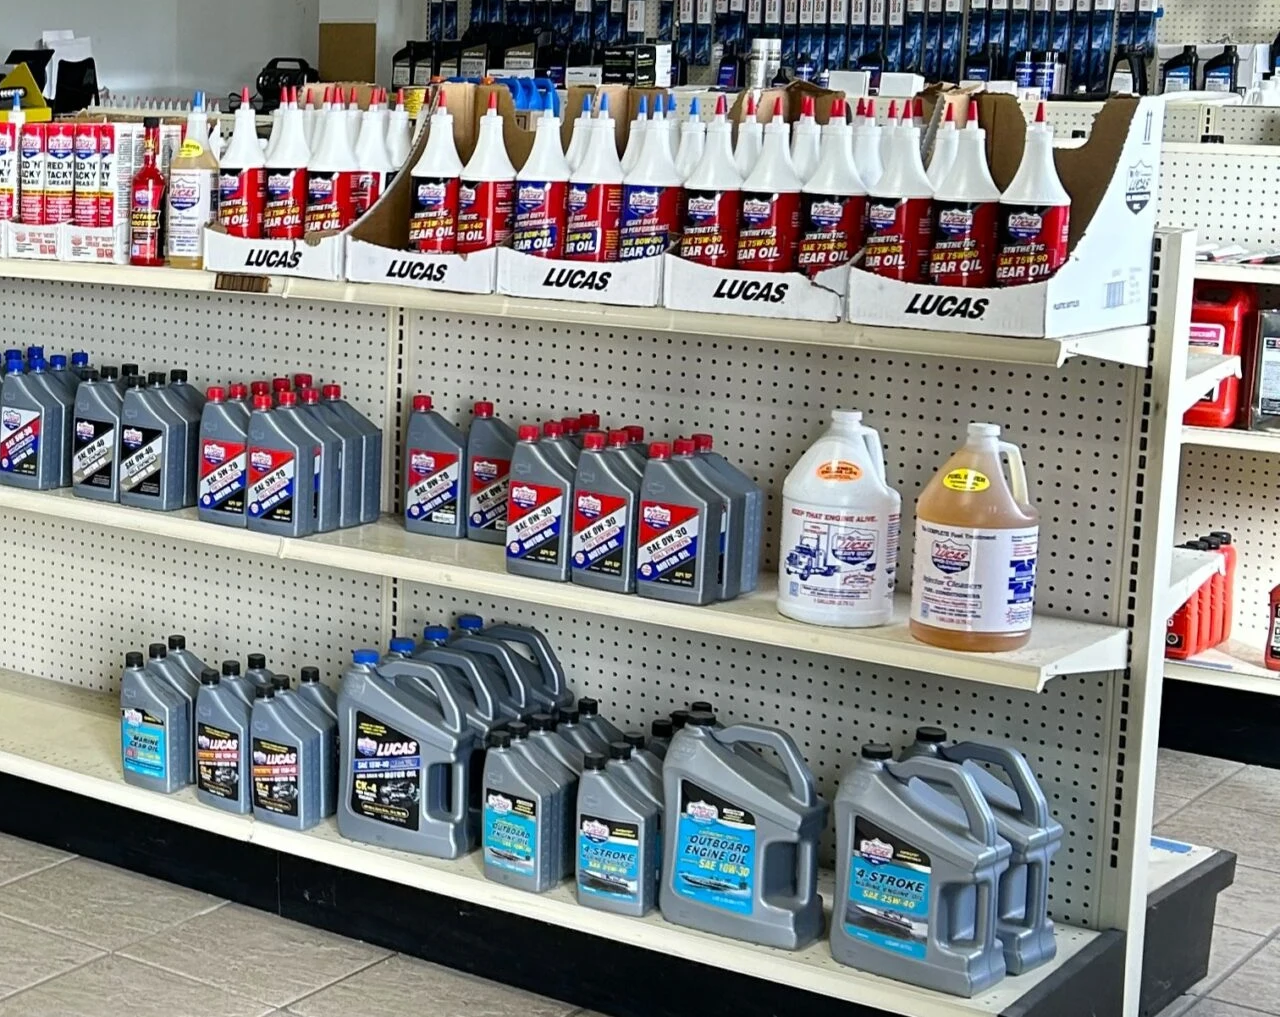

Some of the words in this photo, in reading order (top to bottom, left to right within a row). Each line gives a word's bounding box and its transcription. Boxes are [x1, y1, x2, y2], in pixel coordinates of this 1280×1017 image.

[47, 162, 63, 170] RED
[231, 215, 249, 225] OIL
[283, 215, 301, 225] OIL
[323, 219, 341, 229] OIL
[409, 229, 433, 240] GEAR
[436, 226, 455, 236] OIL
[467, 231, 484, 240] OIL
[534, 238, 553, 248] OIL
[694, 236, 722, 244] 75W-90
[748, 238, 776, 246] 75W-90
[935, 239, 976, 249] SYNTHETIC
[576, 241, 595, 251] OIL
[705, 244, 726, 255] OIL
[802, 243, 815, 251] SAE
[817, 242, 847, 250] 75W-90
[1003, 244, 1045, 254] SYNTHETIC
[758, 247, 780, 258] OIL
[799, 252, 825, 263] GEAR
[829, 251, 849, 262] OIL
[933, 253, 945, 261] SAE
[245, 249, 303, 268] LUCAS
[883, 255, 905, 266] OIL
[1000, 257, 1013, 265] SAE
[1016, 254, 1048, 264] 75W-90
[386, 260, 448, 281] LUCAS
[930, 262, 955, 274] GEAR
[960, 260, 983, 271] OIL
[997, 266, 1025, 278] GEAR
[1028, 264, 1051, 277] OIL
[543, 267, 612, 290] LUCAS
[713, 279, 789, 303] LUCAS
[905, 293, 990, 319] LUCAS
[415, 486, 427, 496] SAE
[515, 521, 528, 532] SAE
[529, 507, 552, 524] 0W-30
[806, 511, 822, 520] THAT
[580, 531, 592, 543] SAE
[593, 516, 616, 534] 0W-30
[646, 542, 660, 555] SAE
[662, 527, 687, 545] 0W-30
[934, 548, 968, 559] LUCAS
[656, 556, 678, 572] MOTOR
[679, 549, 691, 559] OIL
[134, 735, 159, 745] MARINE
[210, 739, 238, 750] LUCAS
[377, 741, 417, 756] LUCAS
[267, 753, 296, 764] LUCAS
[358, 761, 368, 769] SAE
[356, 780, 377, 793] CK-4
[690, 835, 750, 854] OUTBOARD
[584, 846, 635, 861] 4-STROKE
[685, 844, 726, 861] ENGINE
[729, 852, 746, 865] OIL
[699, 858, 717, 871] SAE
[719, 862, 750, 877] 10W-30
[856, 868, 925, 893] 4-STROKE
[863, 889, 879, 901] SAE
[881, 893, 915, 909] 25W-40
